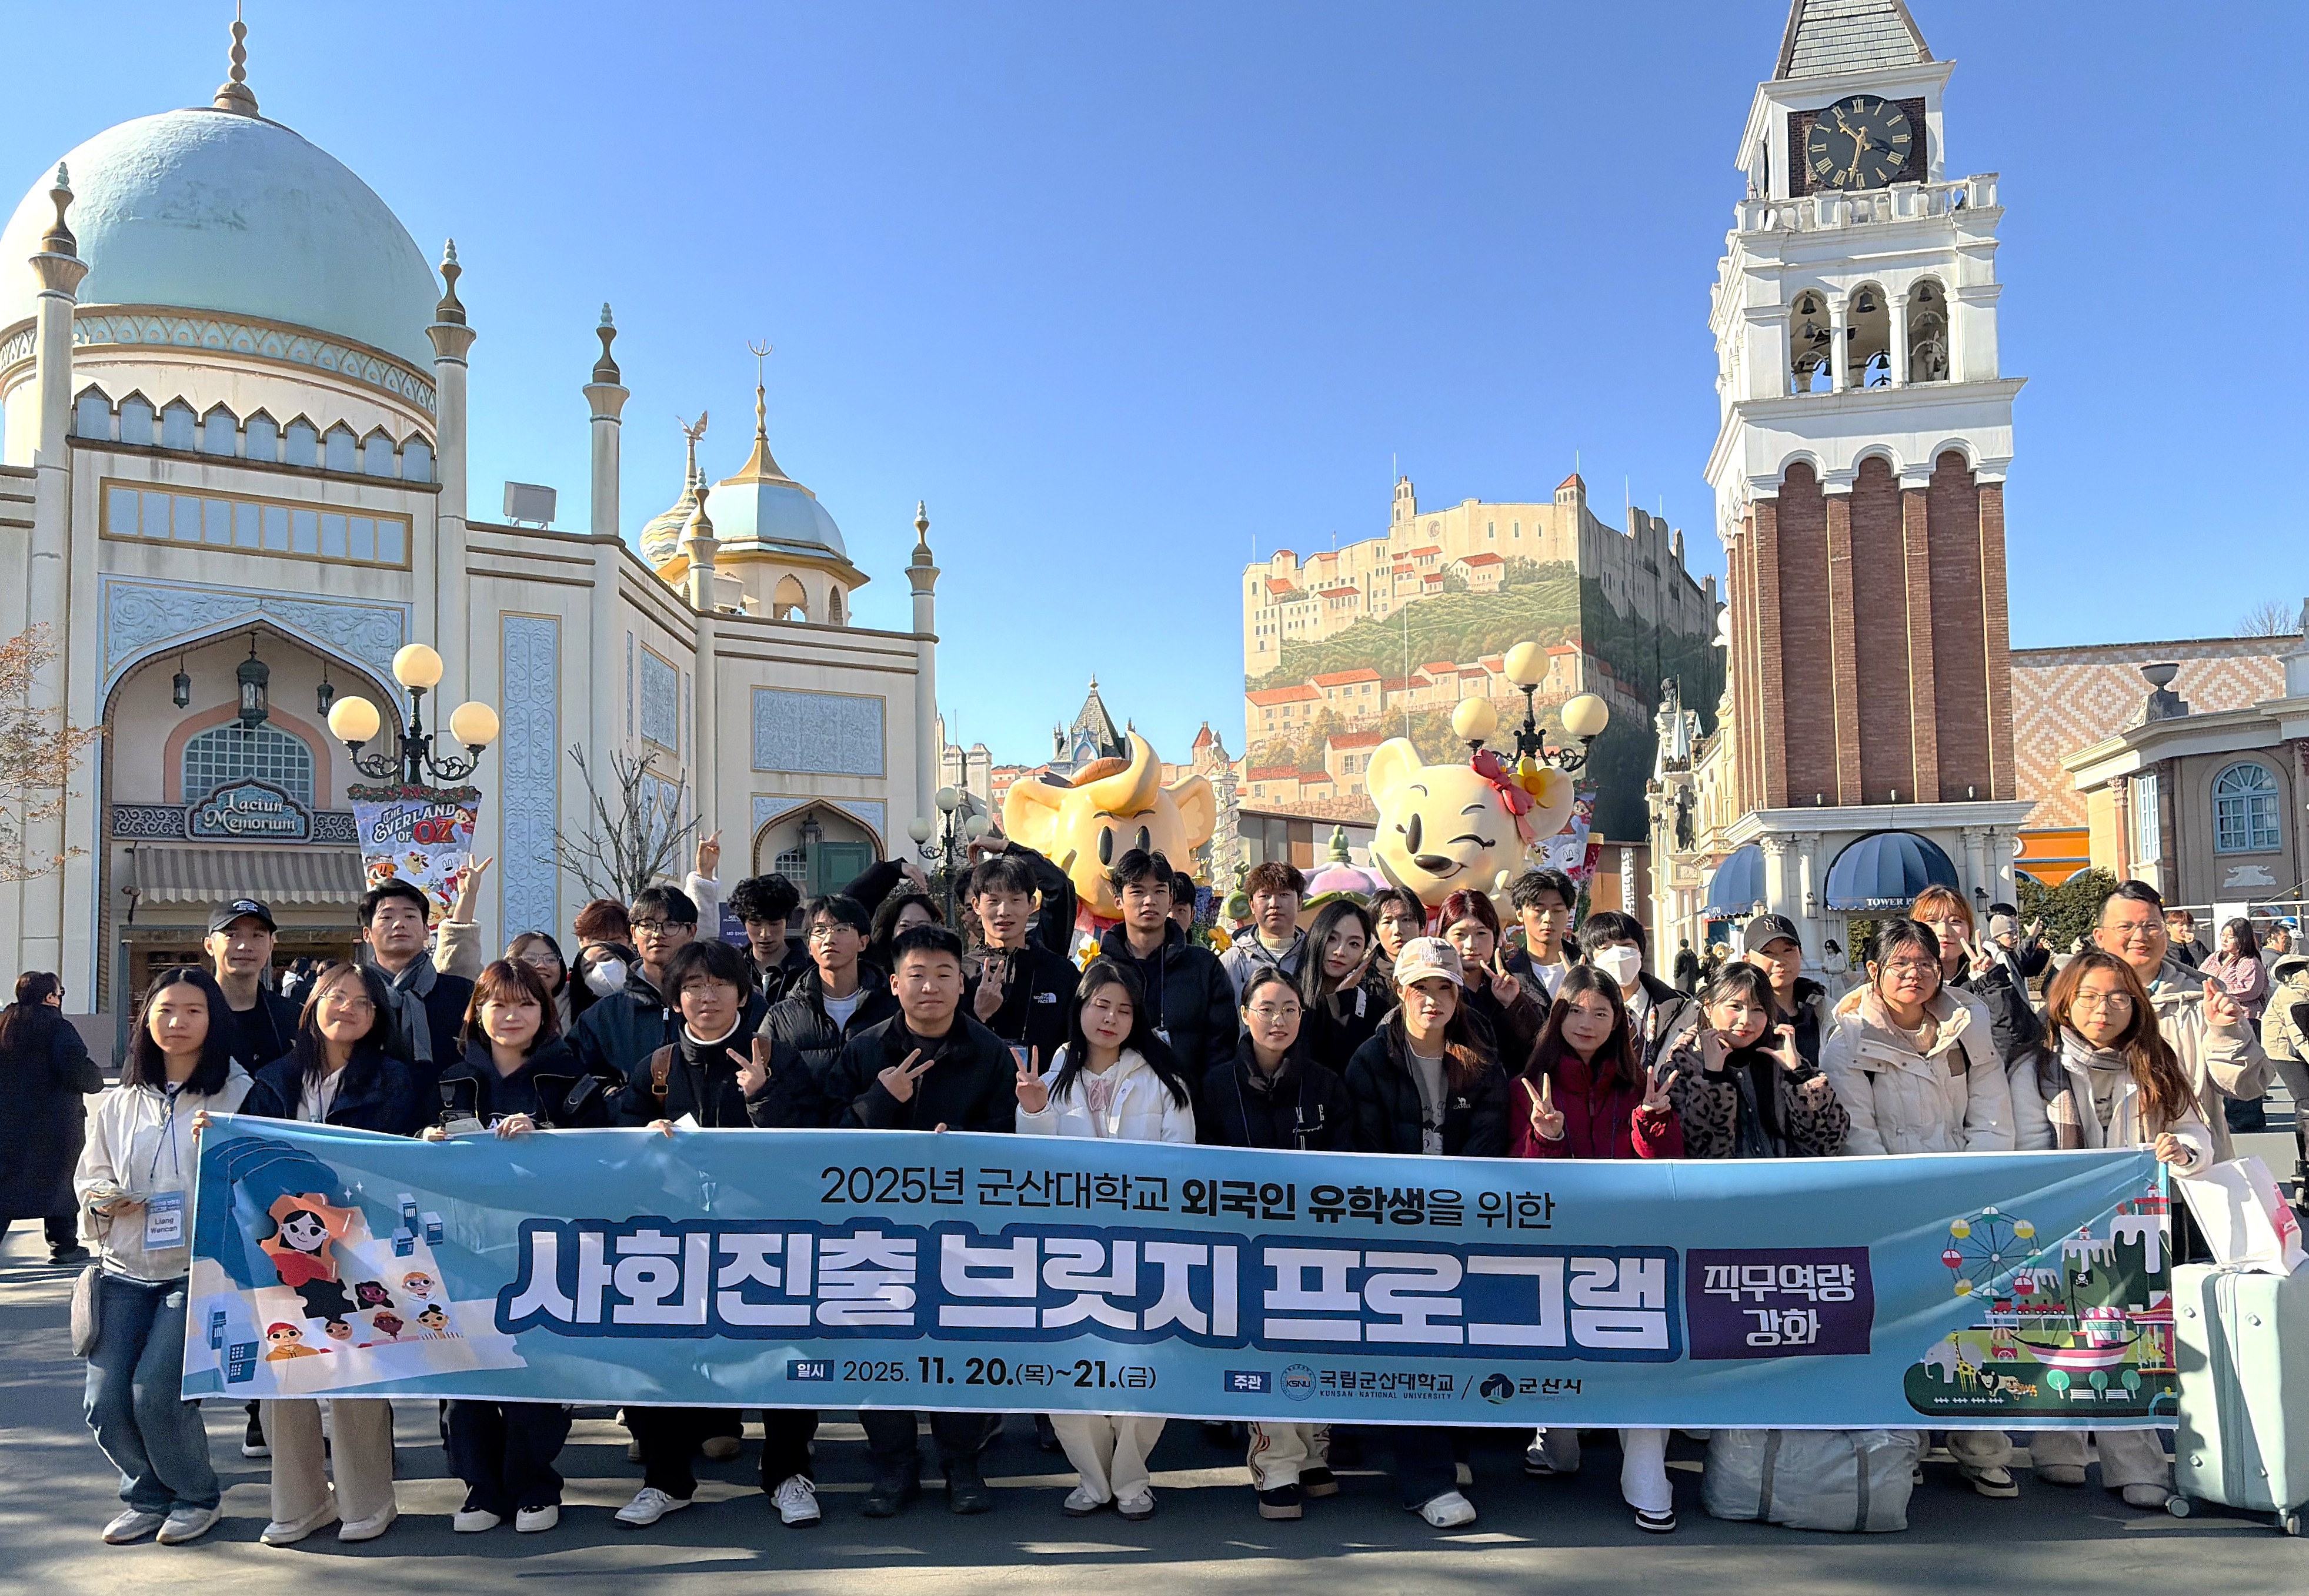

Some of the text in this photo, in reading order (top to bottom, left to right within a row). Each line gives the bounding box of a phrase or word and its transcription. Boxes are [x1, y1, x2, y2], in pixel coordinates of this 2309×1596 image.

[1852, 99, 1864, 113] XII
[225, 793, 282, 814] Laciun
[382, 806, 402, 824] THE
[205, 809, 295, 833] Memorium
[373, 803, 456, 842] EVERLAND
[398, 816, 457, 844] OF OZ
[1866, 898, 1904, 906] TOWER
[821, 1166, 1556, 1229] 2025년 군산대학교 외국인 유학생을 위한
[509, 1229, 1670, 1350] 사회진출 브릿지 프로그램
[1704, 1264, 1856, 1302] 직무역량
[1743, 1308, 1821, 1347] 강화
[796, 1363, 825, 1378] 일시
[843, 1361, 910, 1382] 2025.
[918, 1356, 955, 1384] 11.
[1320, 1370, 1454, 1391] 국립군산대학교
[1234, 1375, 1262, 1390] 주관
[1519, 1378, 1582, 1394] 군산시
